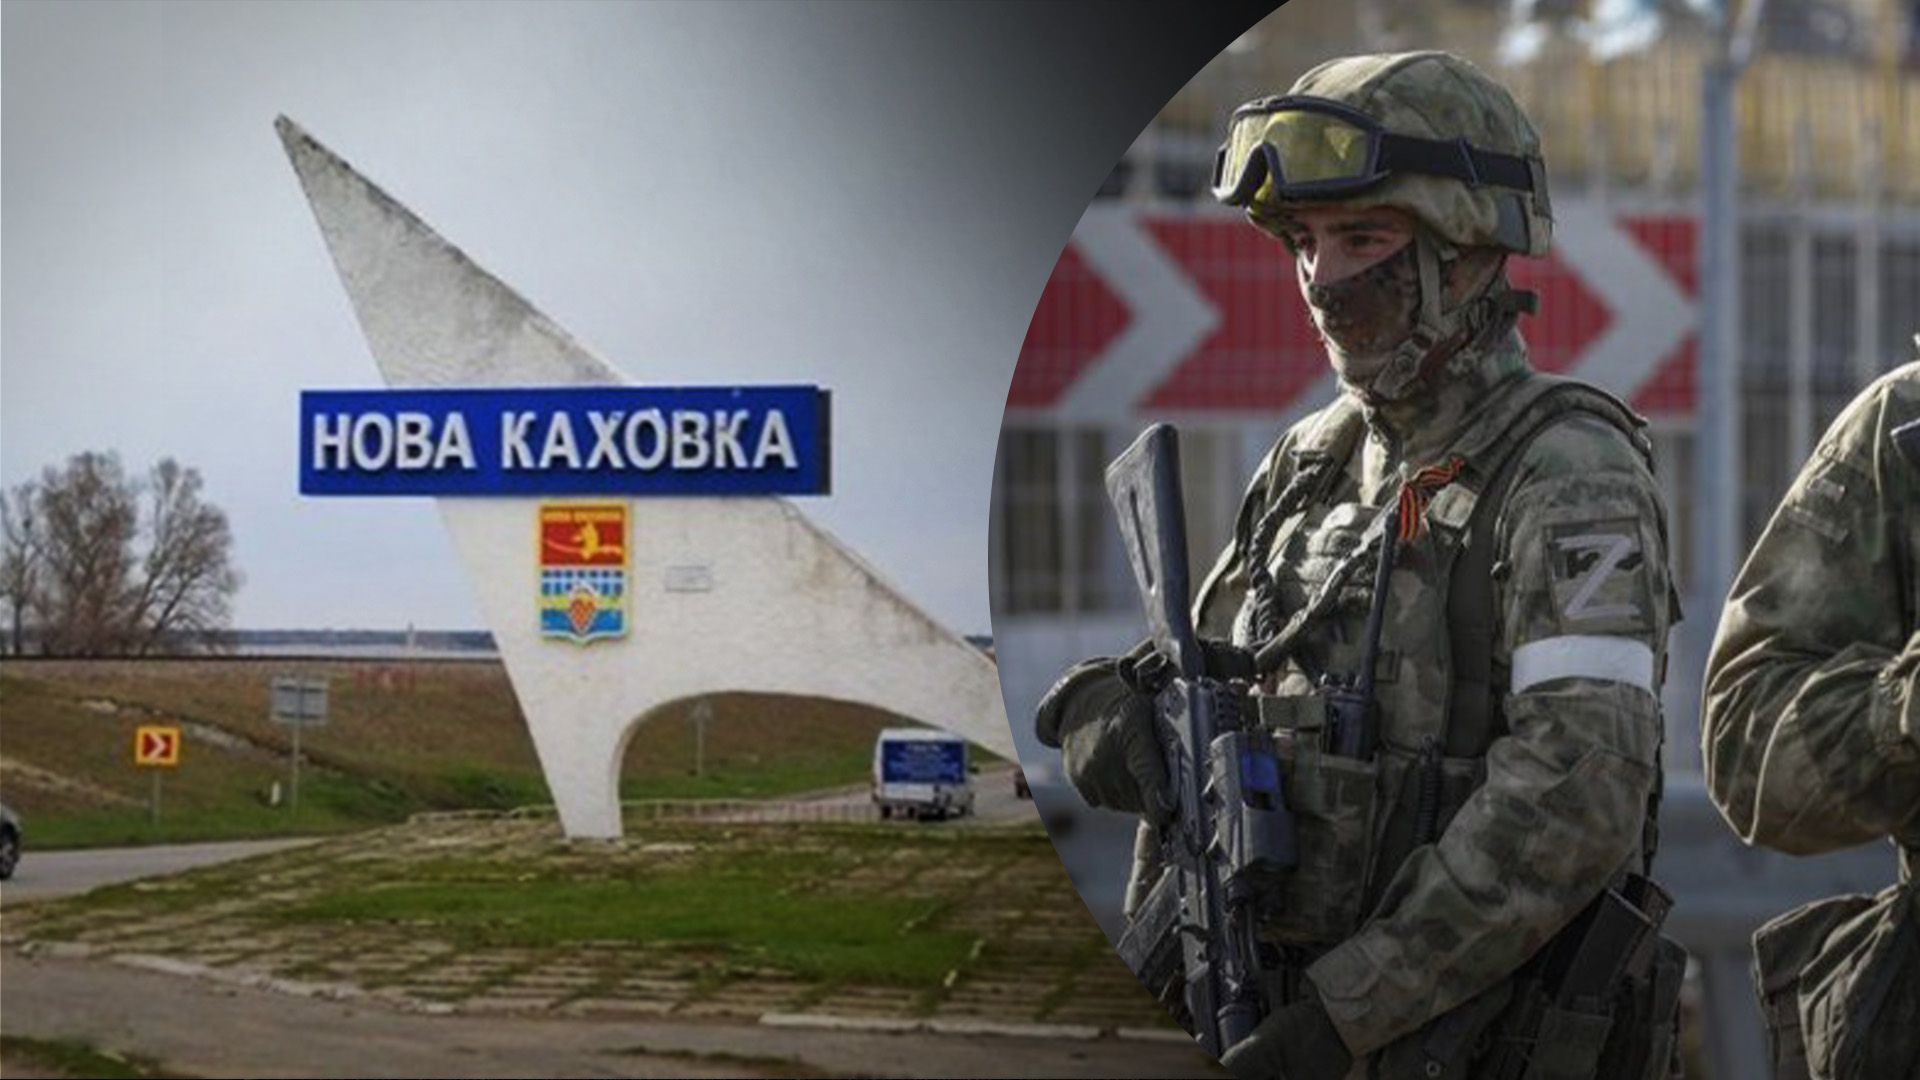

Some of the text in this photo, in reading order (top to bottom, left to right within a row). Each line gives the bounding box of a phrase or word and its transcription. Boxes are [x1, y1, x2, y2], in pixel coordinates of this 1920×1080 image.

[313, 408, 799, 470] НОВА КАХОВКА
[1555, 533, 1641, 617] Z
